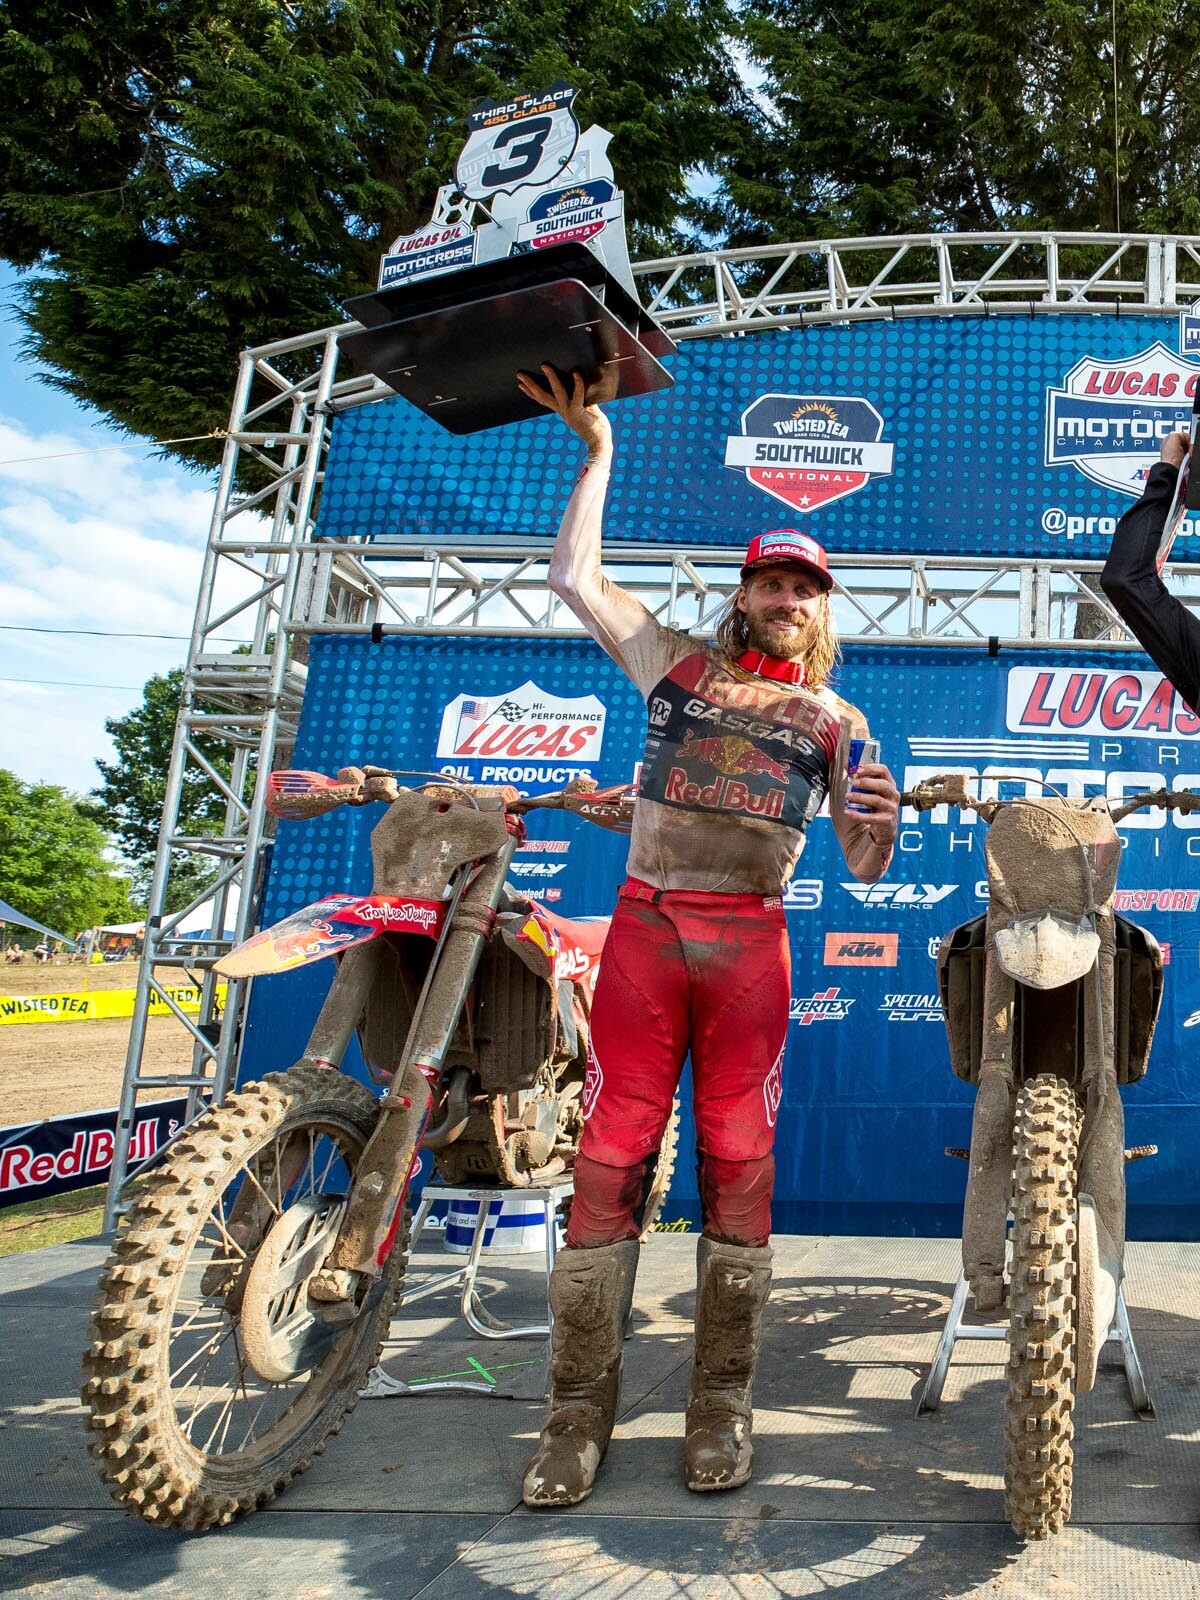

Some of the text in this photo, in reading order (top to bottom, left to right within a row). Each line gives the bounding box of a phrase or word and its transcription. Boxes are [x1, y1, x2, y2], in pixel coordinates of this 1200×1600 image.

[472, 88, 573, 121] THIRD PLACE
[483, 102, 556, 126] 450 CLASS
[481, 116, 552, 187] 3
[546, 196, 580, 215] TWISTED
[580, 196, 594, 206] TEA
[536, 207, 603, 234] SOUTHWICK
[398, 227, 461, 253] LUCAS OIL
[540, 226, 597, 244] NATIONAL
[384, 245, 473, 276] MOTOCROSS
[1084, 371, 1180, 397] LUCAS
[1133, 410, 1184, 419] PRO
[773, 419, 849, 438] TWISTED TEA
[1057, 438, 1155, 447] CHAMPI
[755, 443, 864, 465] SOUTHWICK
[762, 471, 853, 482] NATIONAL
[763, 546, 814, 558] GASGAS
[531, 713, 602, 721] PERFORMANCE
[684, 699, 816, 756] GASGAS
[454, 724, 597, 758] LUCAS
[1102, 744, 1179, 765] PR
[440, 766, 592, 783] OIL PRODUCTS
[665, 767, 724, 807] Red
[723, 780, 786, 818] Bull
[509, 863, 568, 874] FLY
[546, 889, 560, 897] Rate
[839, 883, 960, 903] FLY
[354, 903, 387, 925] Troy
[837, 942, 885, 957] KTM
[1, 998, 59, 1015] WISTED
[62, 997, 88, 1013] TEA
[790, 999, 851, 1013] VERTEX
[880, 994, 943, 1008] SPECIALI
[0, 1131, 86, 1192] Red
[459, 1217, 469, 1225] and
[655, 1218, 692, 1233] orts
